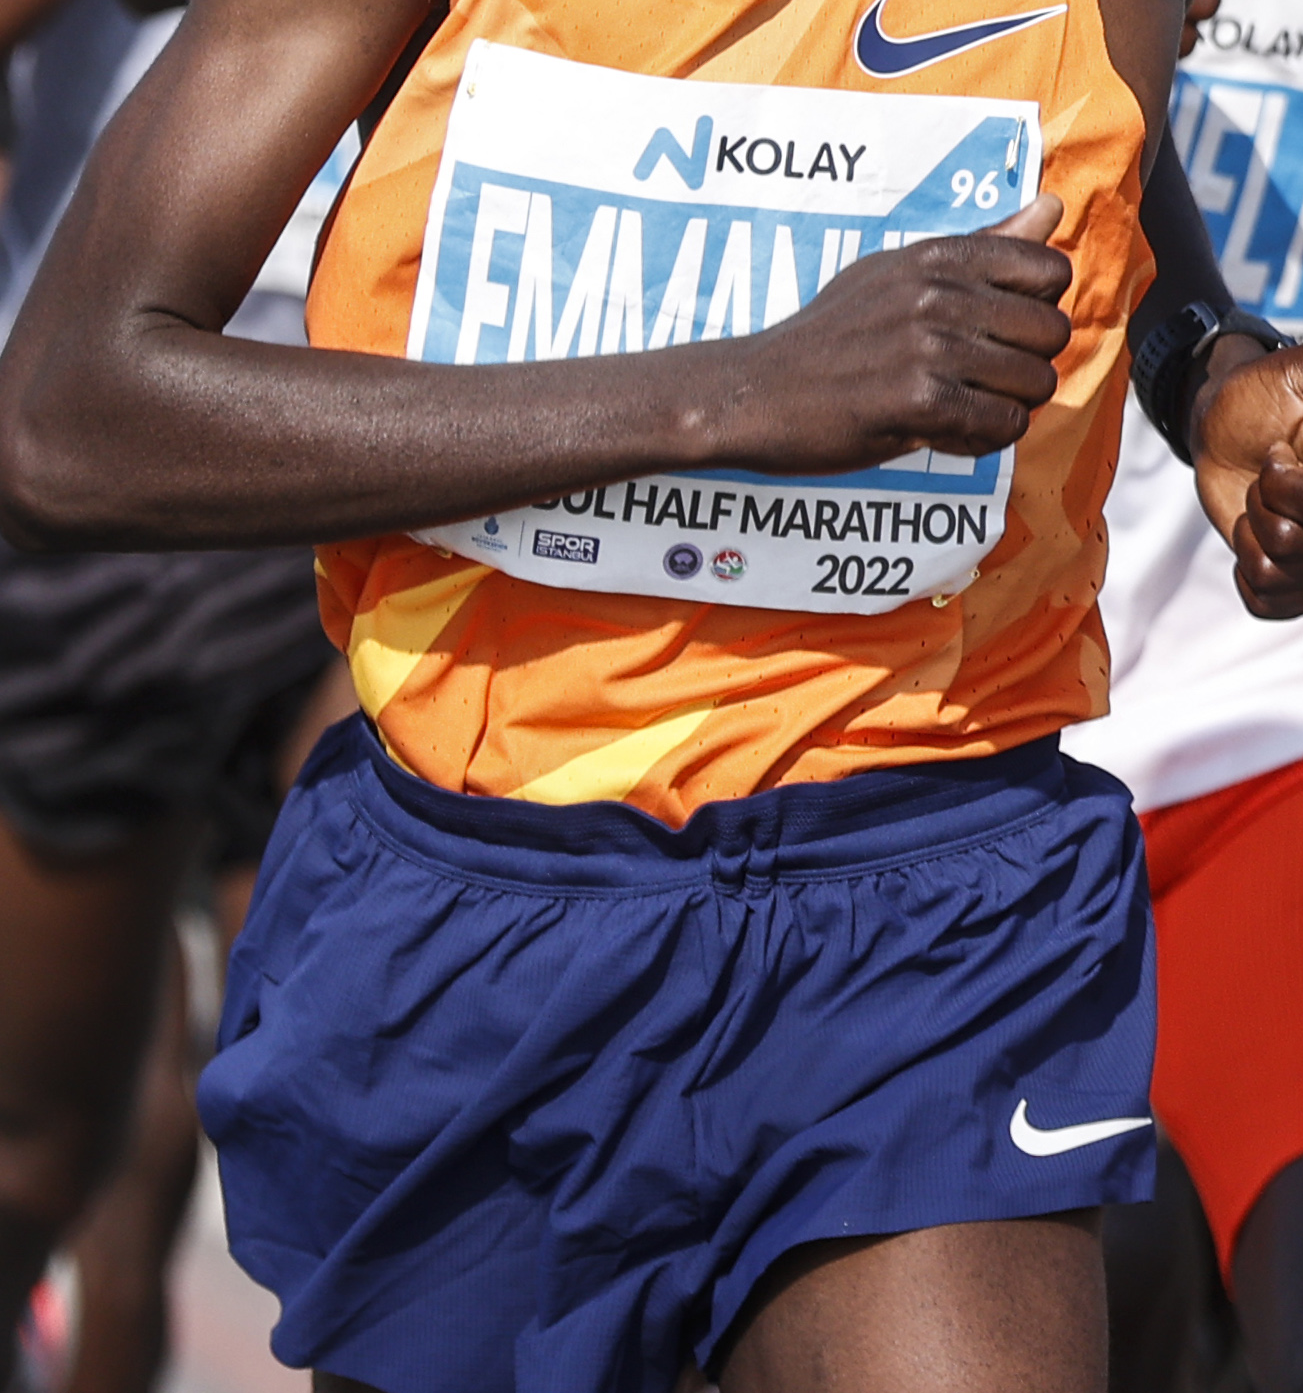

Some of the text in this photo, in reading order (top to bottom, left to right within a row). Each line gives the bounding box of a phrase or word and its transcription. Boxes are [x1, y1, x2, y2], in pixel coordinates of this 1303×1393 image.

[715, 135, 867, 182] KOLAY
[949, 169, 1000, 210] 96
[622, 481, 738, 530] HALF
[738, 494, 988, 546] MARATHON
[537, 532, 595, 553] SPOR
[810, 553, 915, 596] 2022
